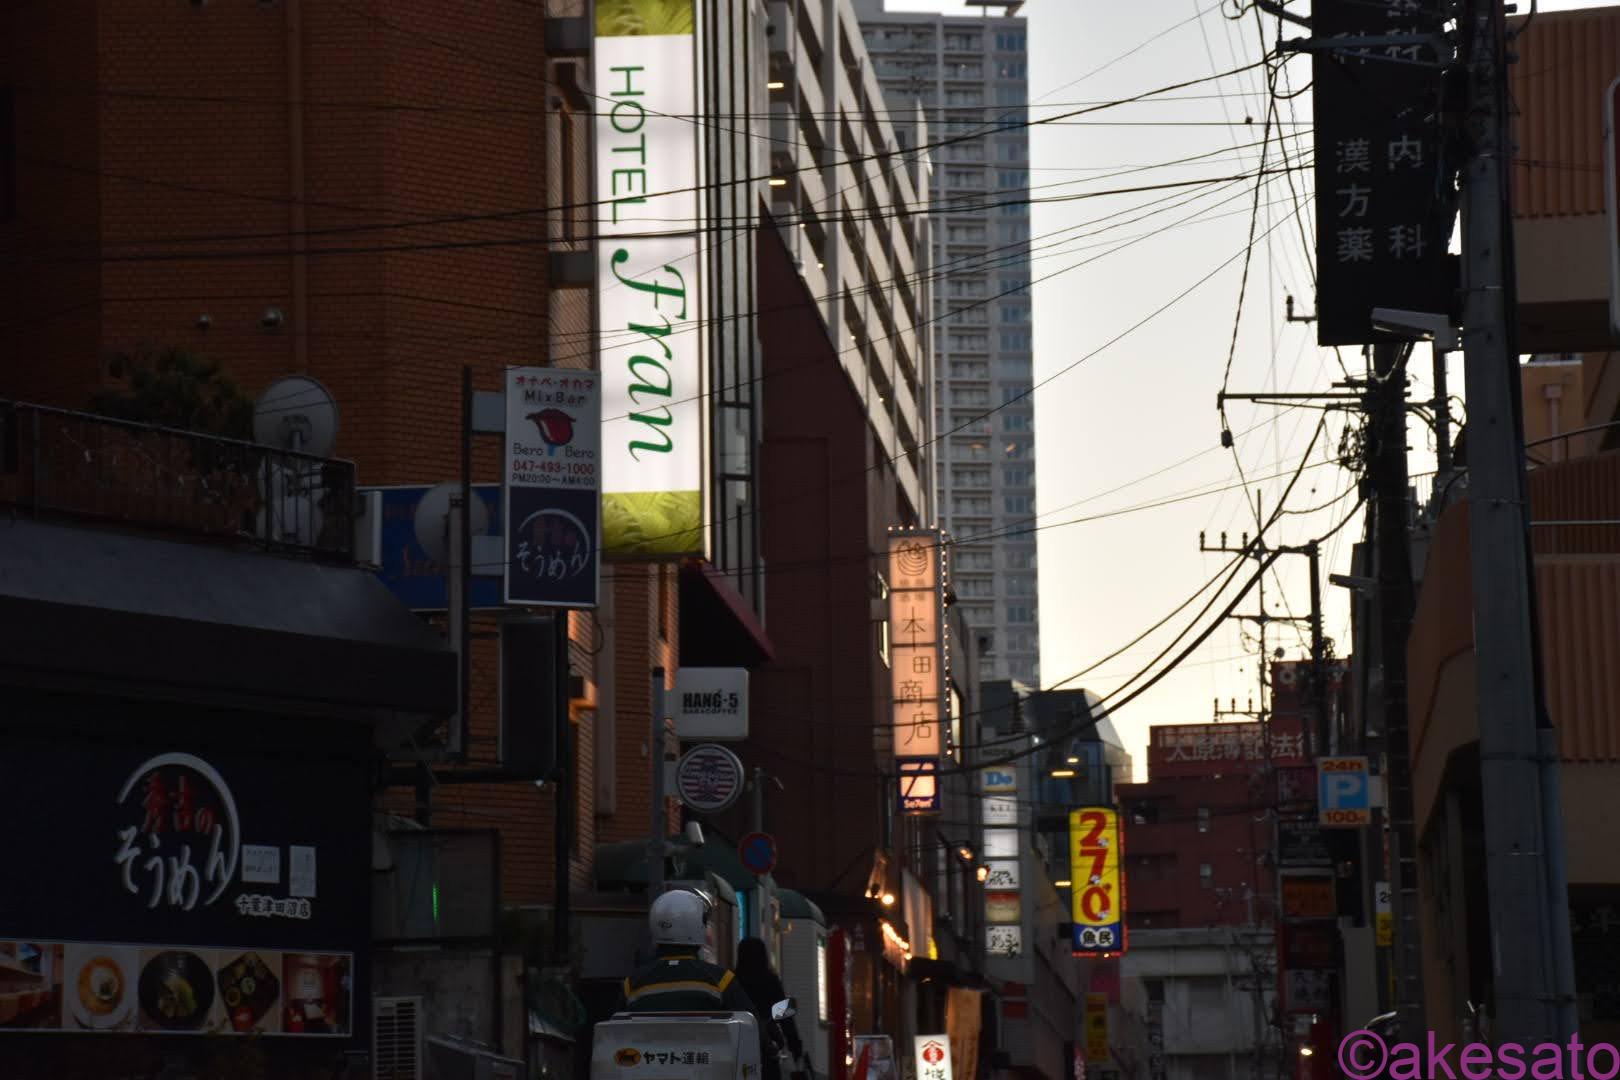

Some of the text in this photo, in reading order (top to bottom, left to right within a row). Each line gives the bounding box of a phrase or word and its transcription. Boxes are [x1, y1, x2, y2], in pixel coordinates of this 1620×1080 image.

[610, 66, 646, 224] HOTEL
[1335, 138, 1374, 262] 漢方薬
[513, 442, 594, 459] Bero Bero
[513, 459, 594, 475] 047-493-1000
[516, 541, 586, 582] そうめん
[900, 606, 932, 746] 本田商店
[1327, 773, 1361, 809] P
[113, 824, 233, 911] そうめん
[1079, 811, 1111, 922] 270
[1083, 930, 1112, 944] 魚民
[643, 1051, 711, 1065] ヤマト運輸
